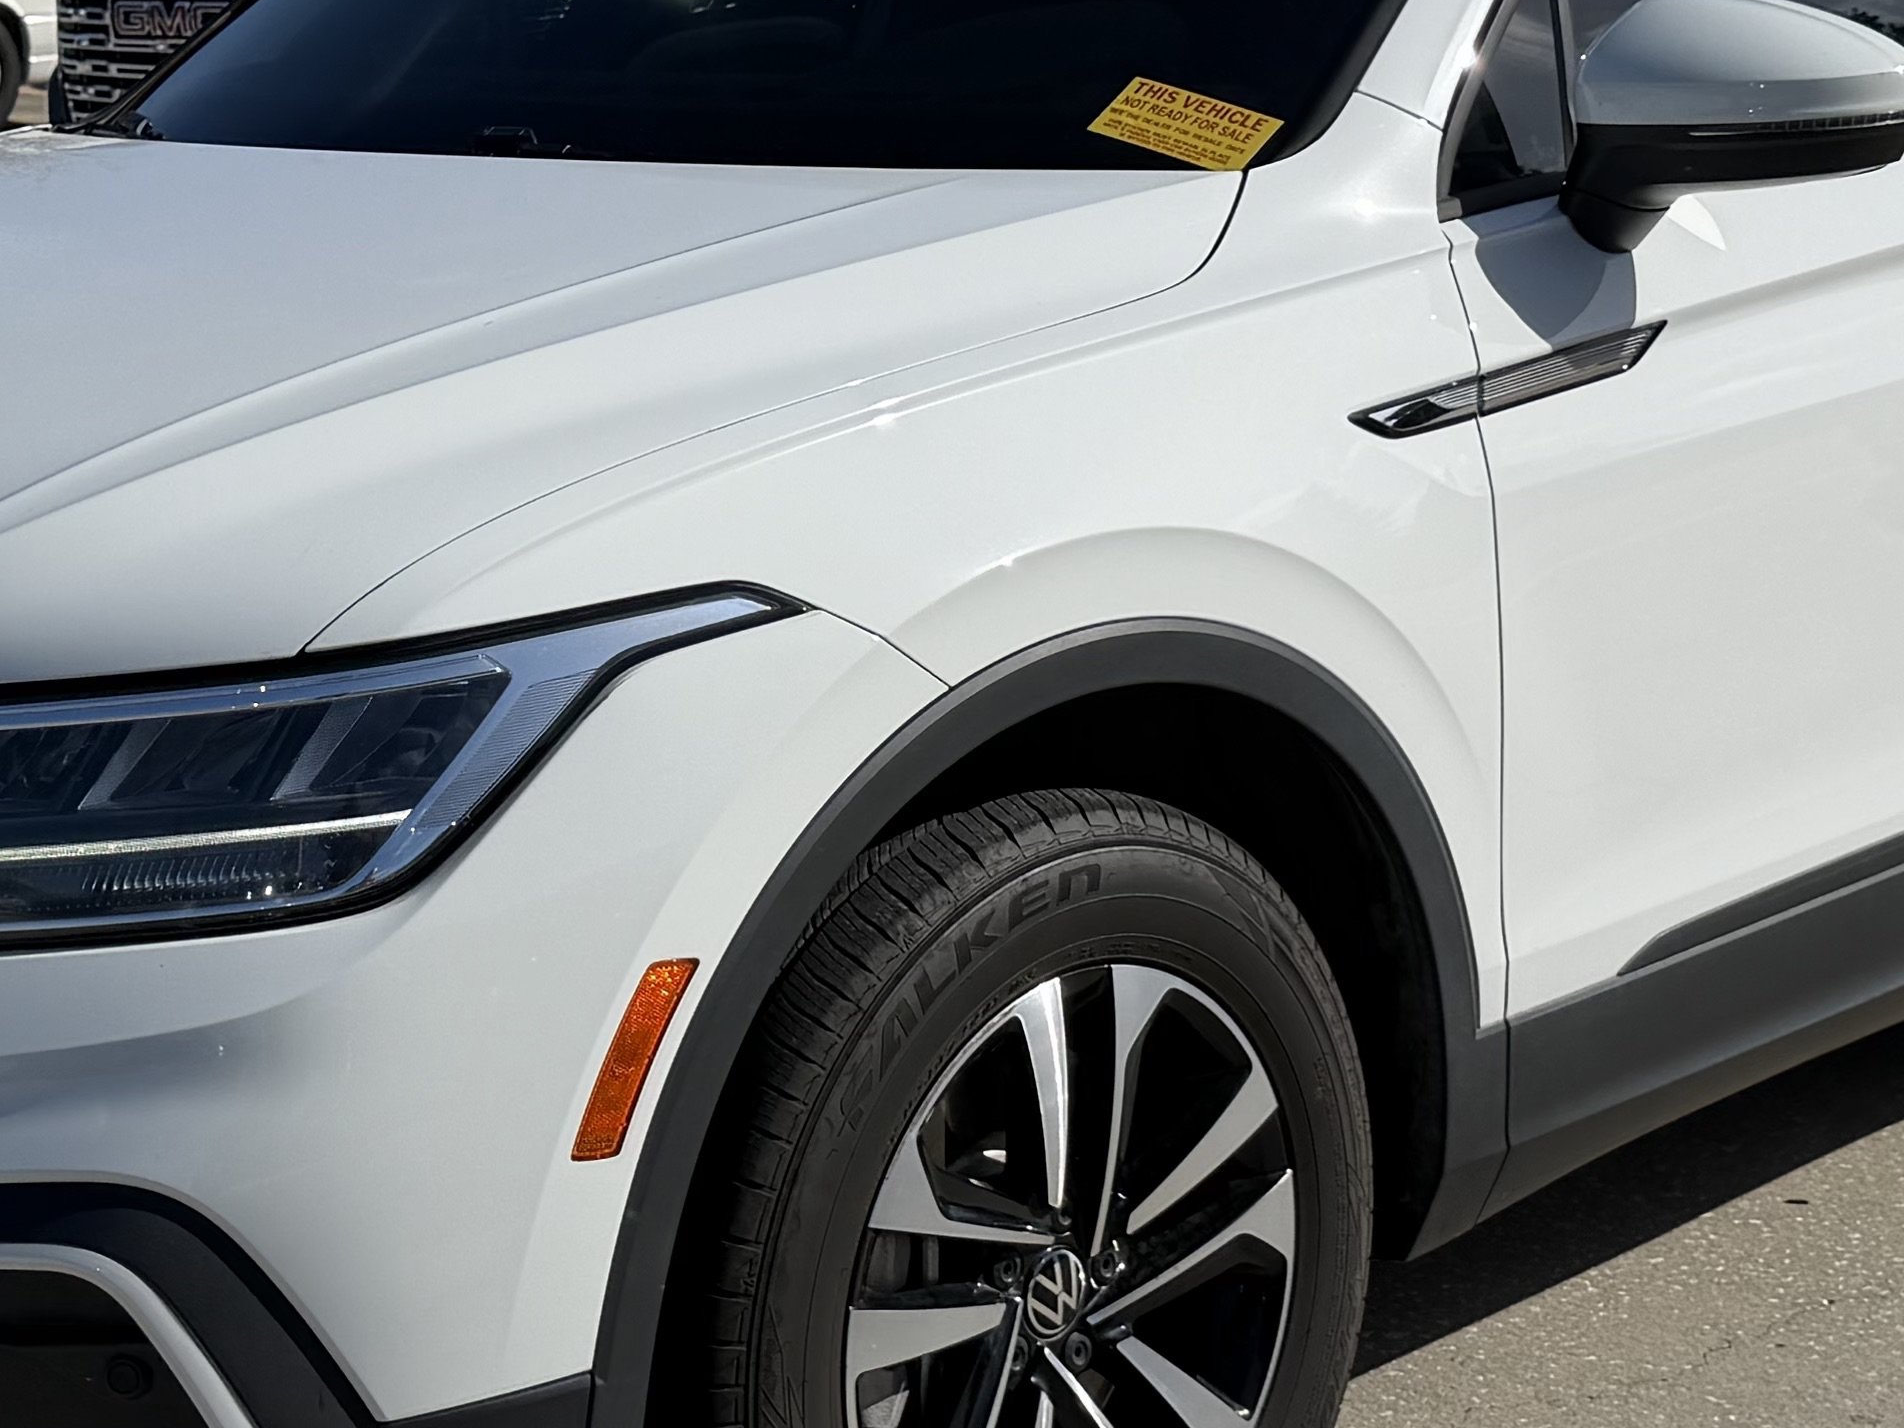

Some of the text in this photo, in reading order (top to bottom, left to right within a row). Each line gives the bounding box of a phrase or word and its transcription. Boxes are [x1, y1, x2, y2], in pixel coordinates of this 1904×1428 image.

[114, 0, 230, 37] GMC
[1120, 95, 1254, 144] NOT READY FOR SALE
[1134, 81, 1269, 132] THIS VEHICLE
[836, 863, 1101, 1137] FALKEN
